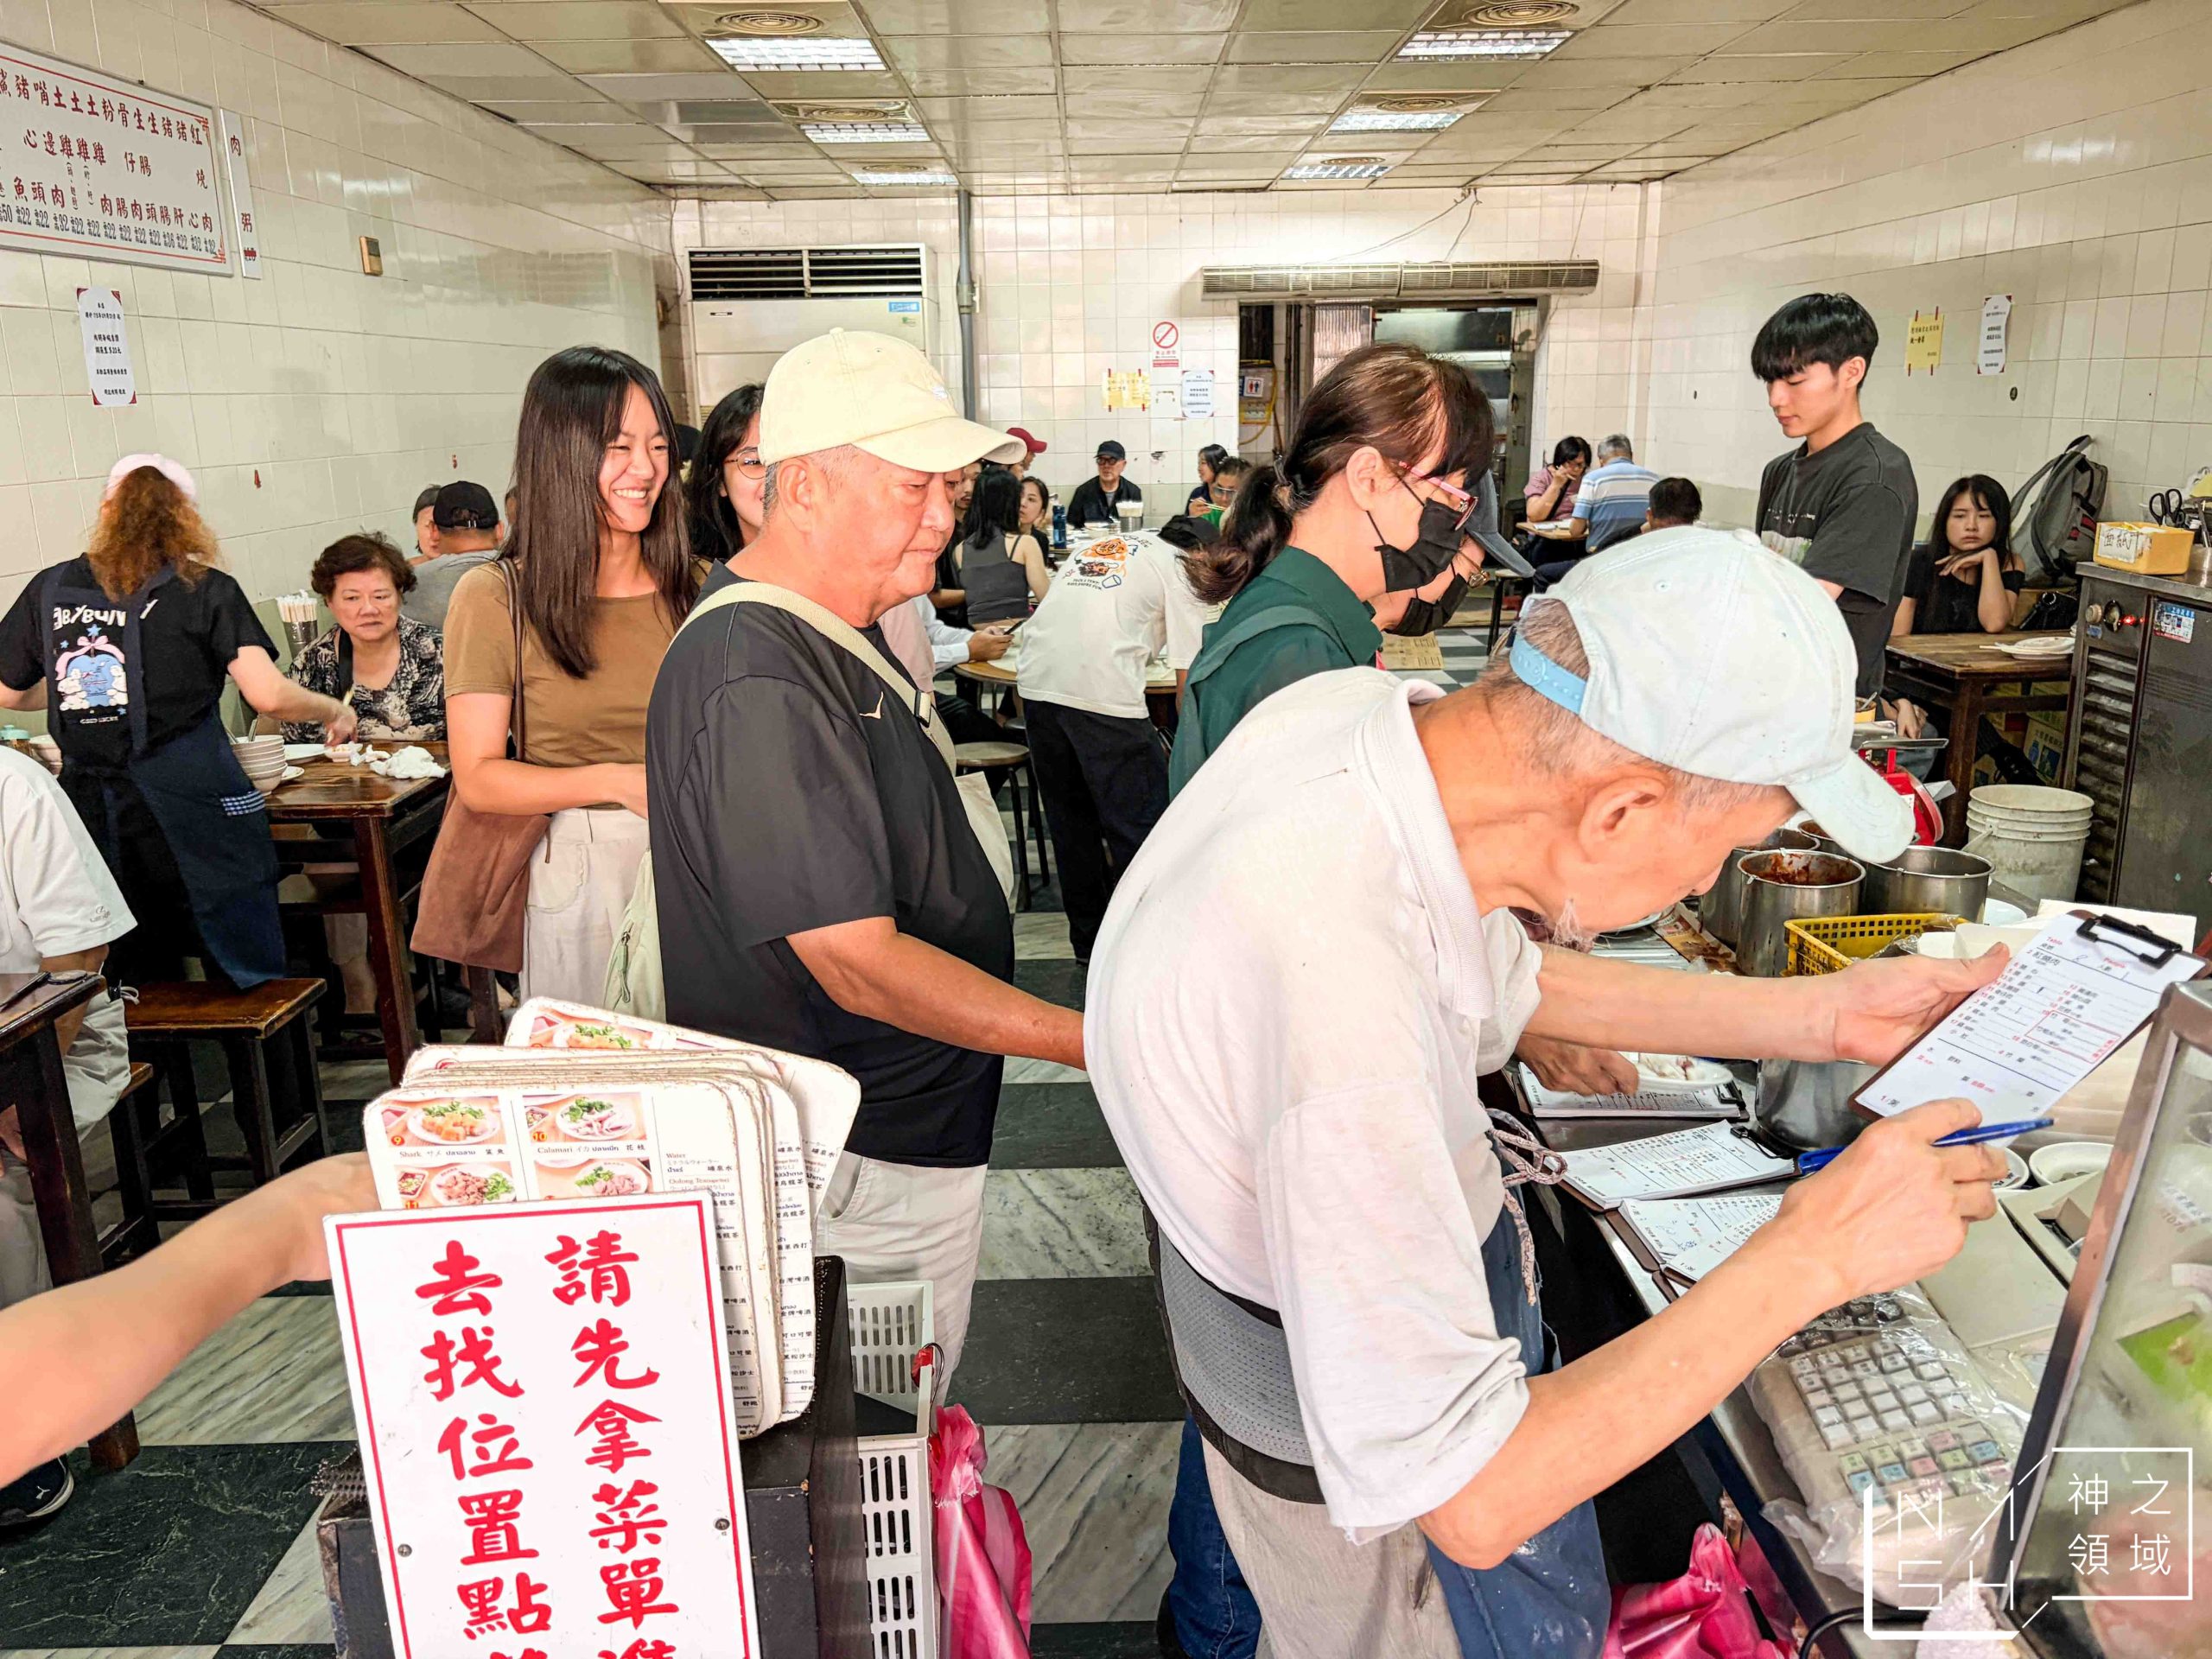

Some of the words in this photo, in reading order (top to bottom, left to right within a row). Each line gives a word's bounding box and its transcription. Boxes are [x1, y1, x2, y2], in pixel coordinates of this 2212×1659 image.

[532, 1131, 548, 1141] 10
[416, 1240, 552, 1659] 去找位置點
